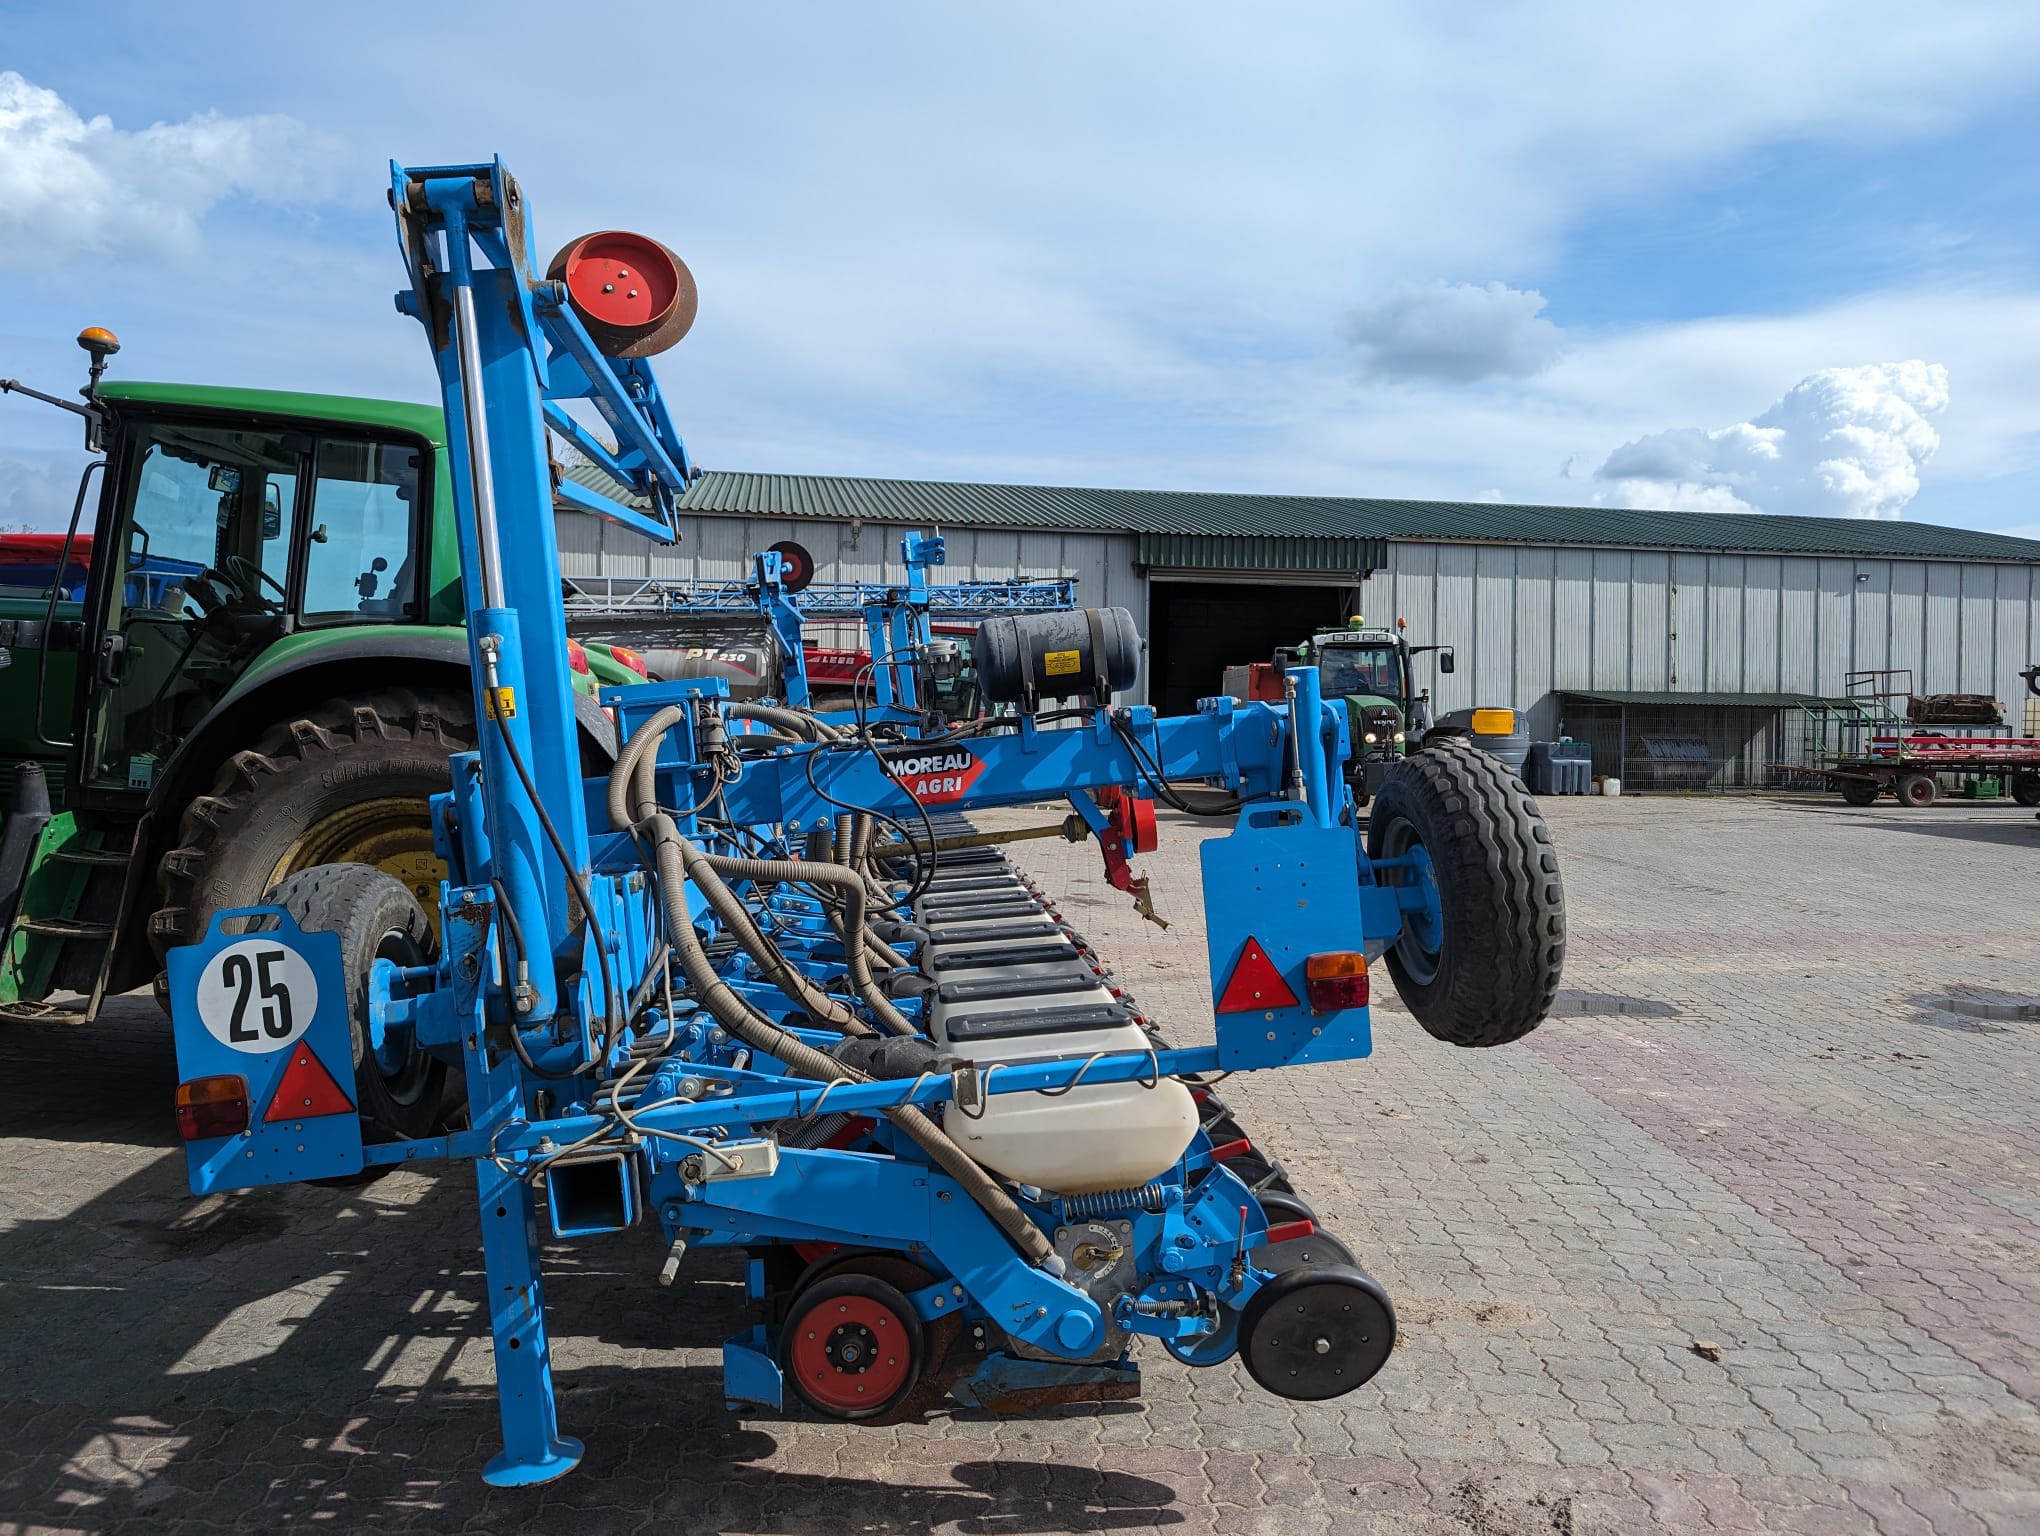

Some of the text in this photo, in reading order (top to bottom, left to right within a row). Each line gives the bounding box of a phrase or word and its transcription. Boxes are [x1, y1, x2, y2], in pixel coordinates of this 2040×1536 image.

[685, 648, 747, 662] PT 230
[886, 752, 971, 777] MOREAU
[915, 776, 963, 796] AGRI
[222, 949, 294, 1043] 25
